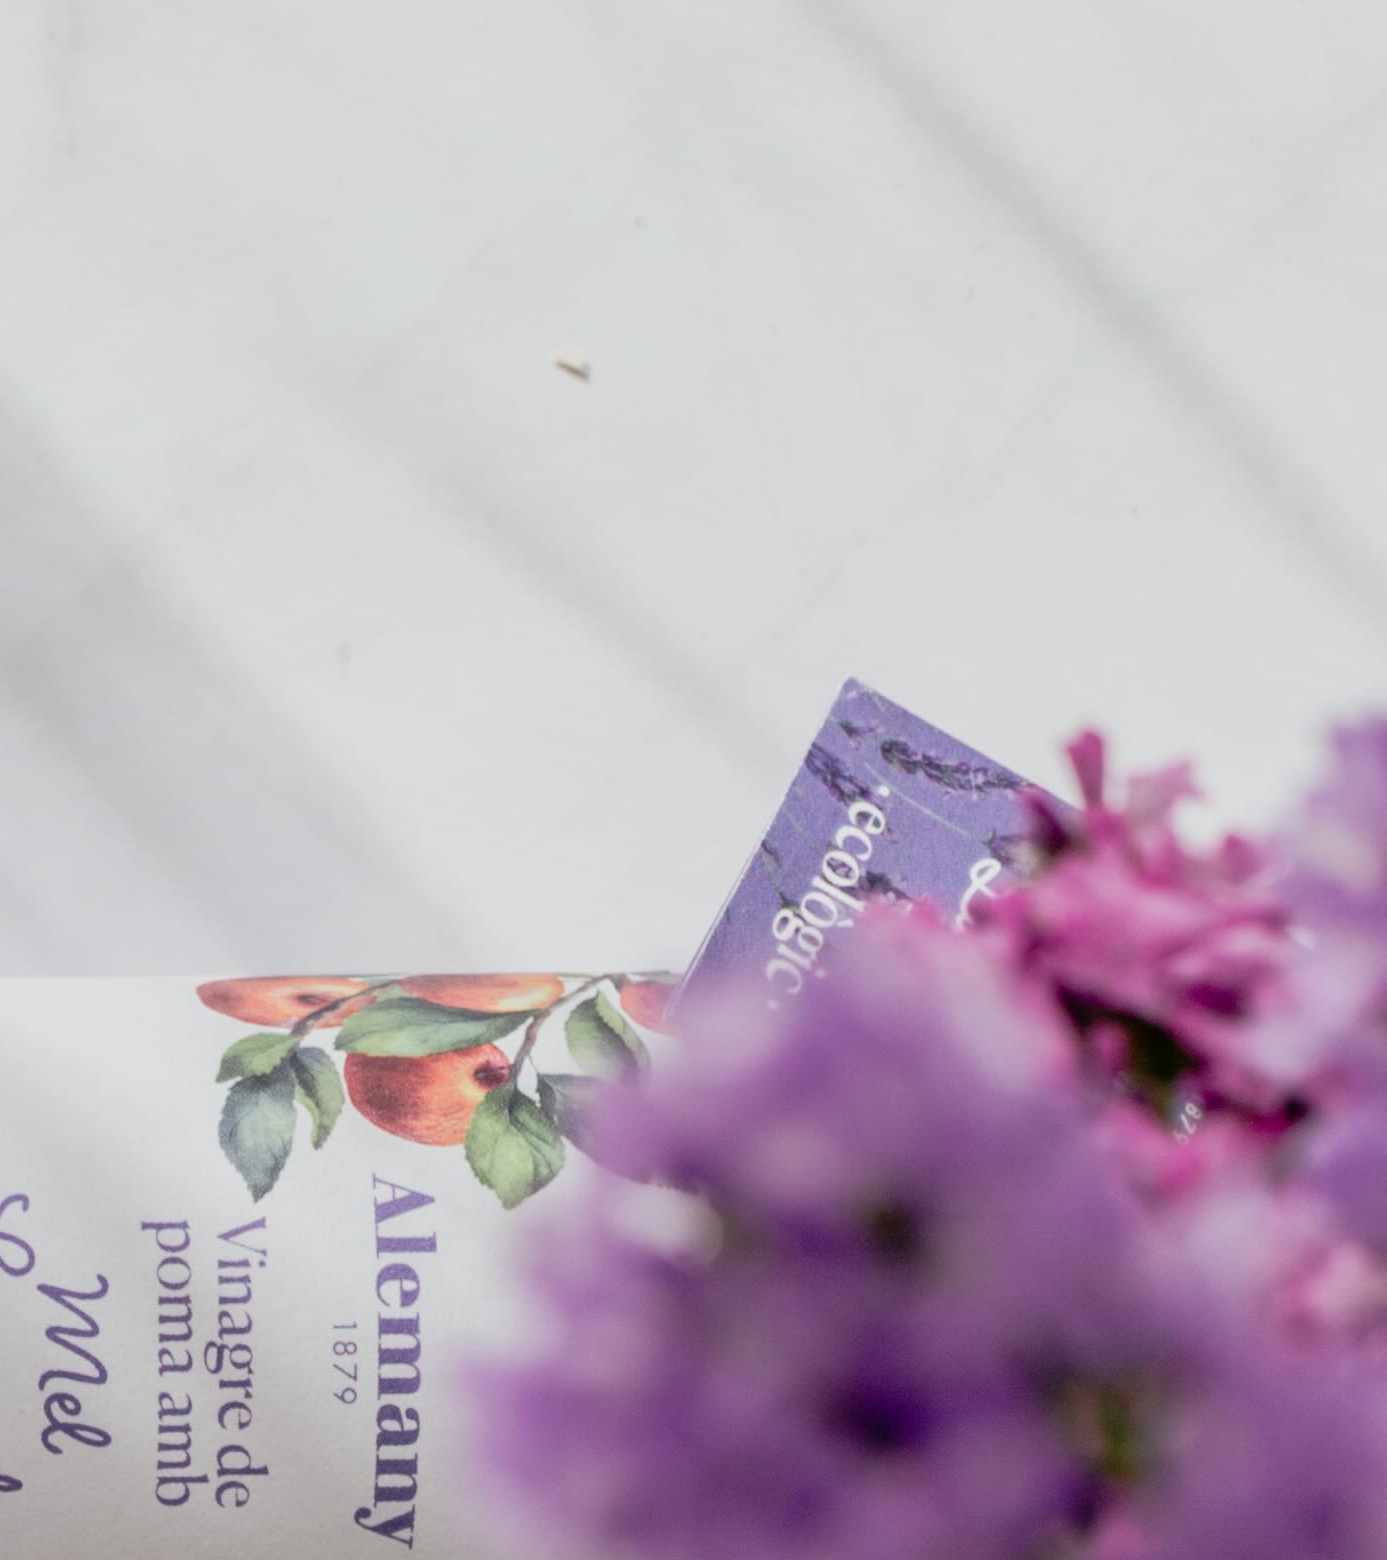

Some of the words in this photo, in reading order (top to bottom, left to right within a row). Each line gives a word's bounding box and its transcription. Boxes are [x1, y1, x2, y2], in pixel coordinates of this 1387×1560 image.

[36, 1272, 113, 1455] Mel
[139, 1219, 196, 1377] poma
[203, 1215, 268, 1431] Vinagre
[332, 1321, 359, 1407] 1879
[354, 1171, 438, 1550] Alemany
[153, 1391, 210, 1508] amb
[215, 1444, 270, 1510] de
